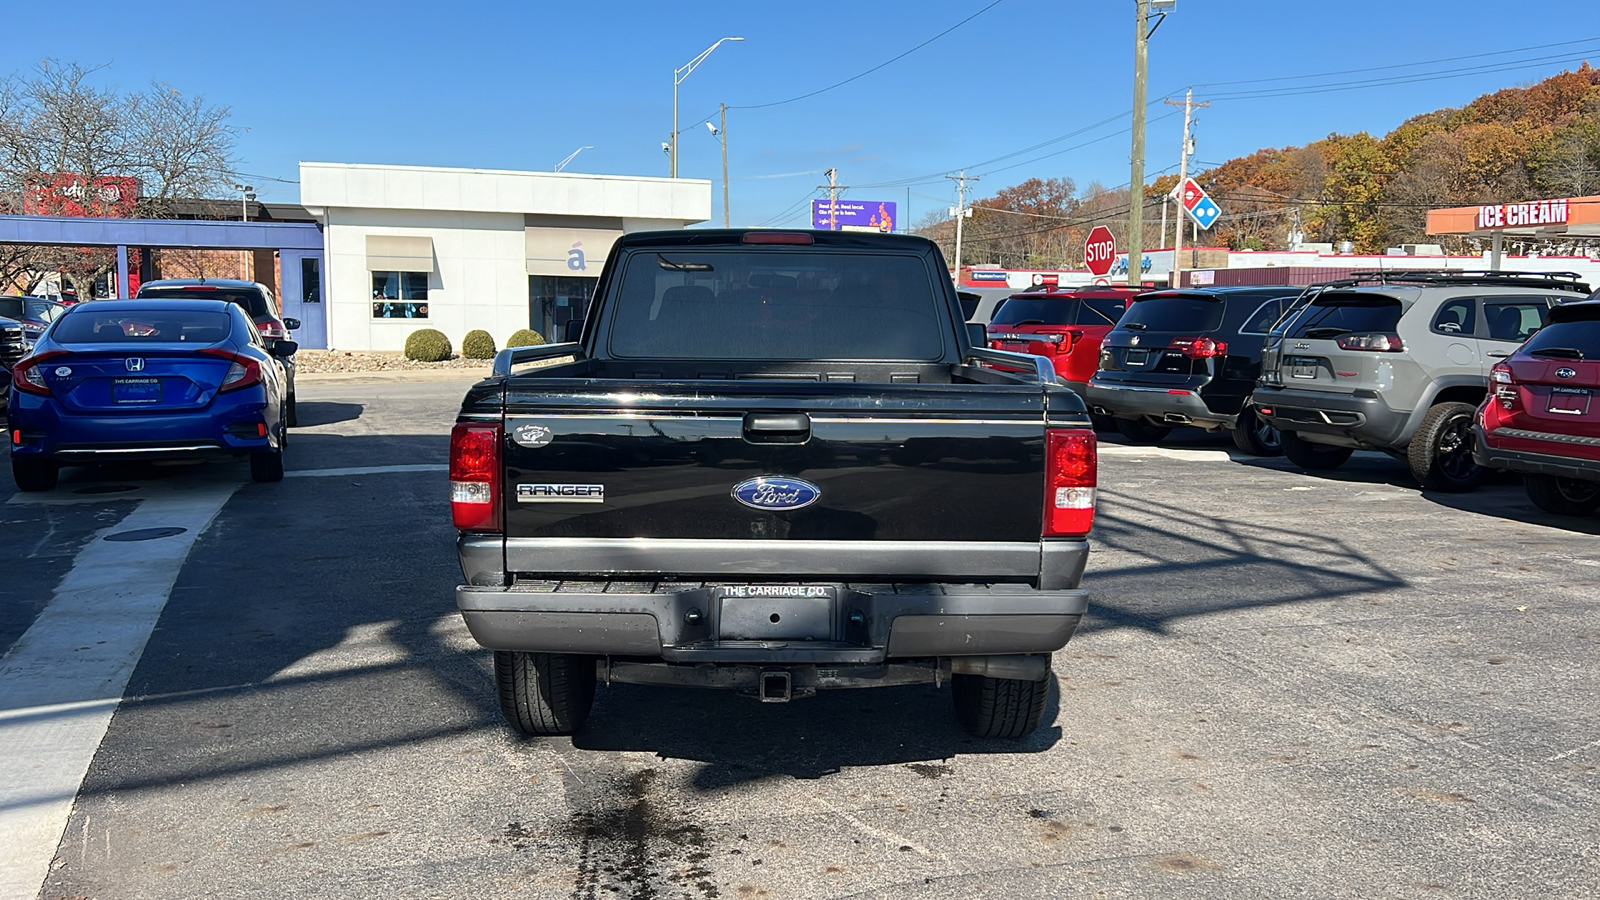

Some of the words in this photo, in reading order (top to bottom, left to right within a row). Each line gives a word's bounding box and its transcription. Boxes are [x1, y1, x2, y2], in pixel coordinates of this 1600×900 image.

[1479, 204, 1505, 227] ICE
[1506, 199, 1568, 225] CREAM
[1086, 241, 1114, 262] STOP
[517, 485, 603, 496] RANGER
[752, 483, 800, 504] Ford
[723, 586, 746, 596] THE
[747, 586, 806, 596] CARRIAGE
[807, 586, 827, 596] CO.
